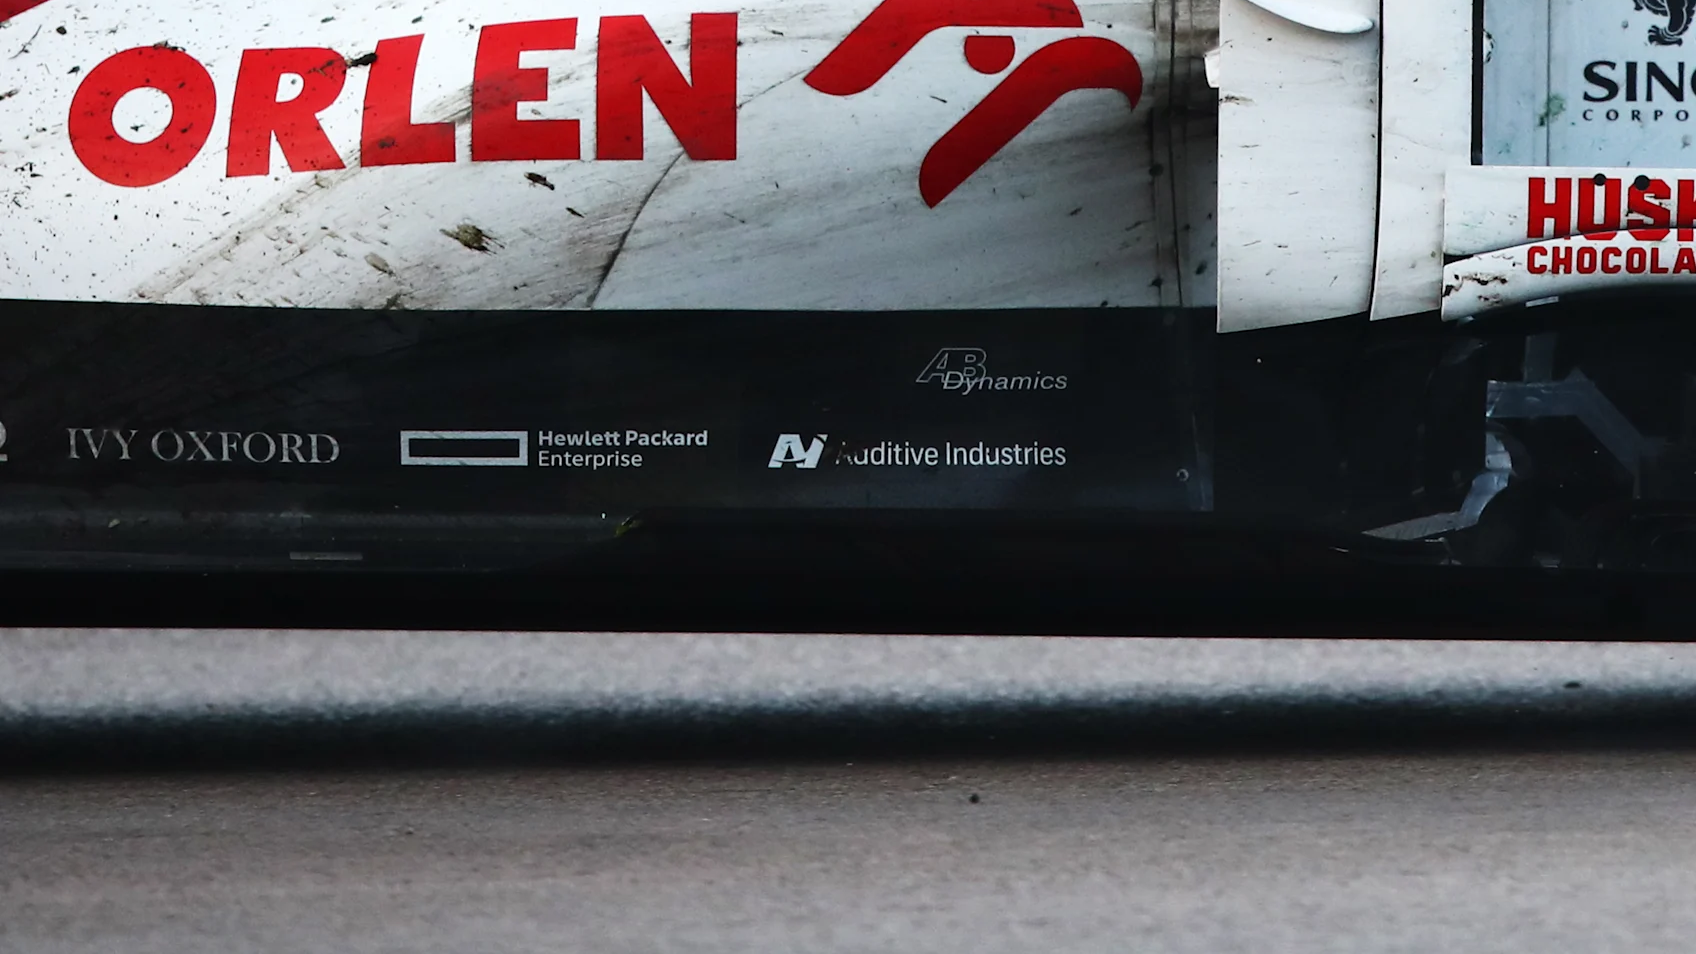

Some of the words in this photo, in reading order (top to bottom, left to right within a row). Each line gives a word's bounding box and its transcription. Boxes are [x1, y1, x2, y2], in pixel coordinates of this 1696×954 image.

[68, 15, 738, 187] ORLEN
[943, 371, 1068, 395] Dynamics
[67, 428, 138, 460] IVY
[151, 430, 340, 464] OXFORD
[538, 430, 621, 447] Hewlett
[625, 430, 709, 447] Packard
[538, 450, 643, 471] Enterprise
[946, 441, 1067, 466] Industries
